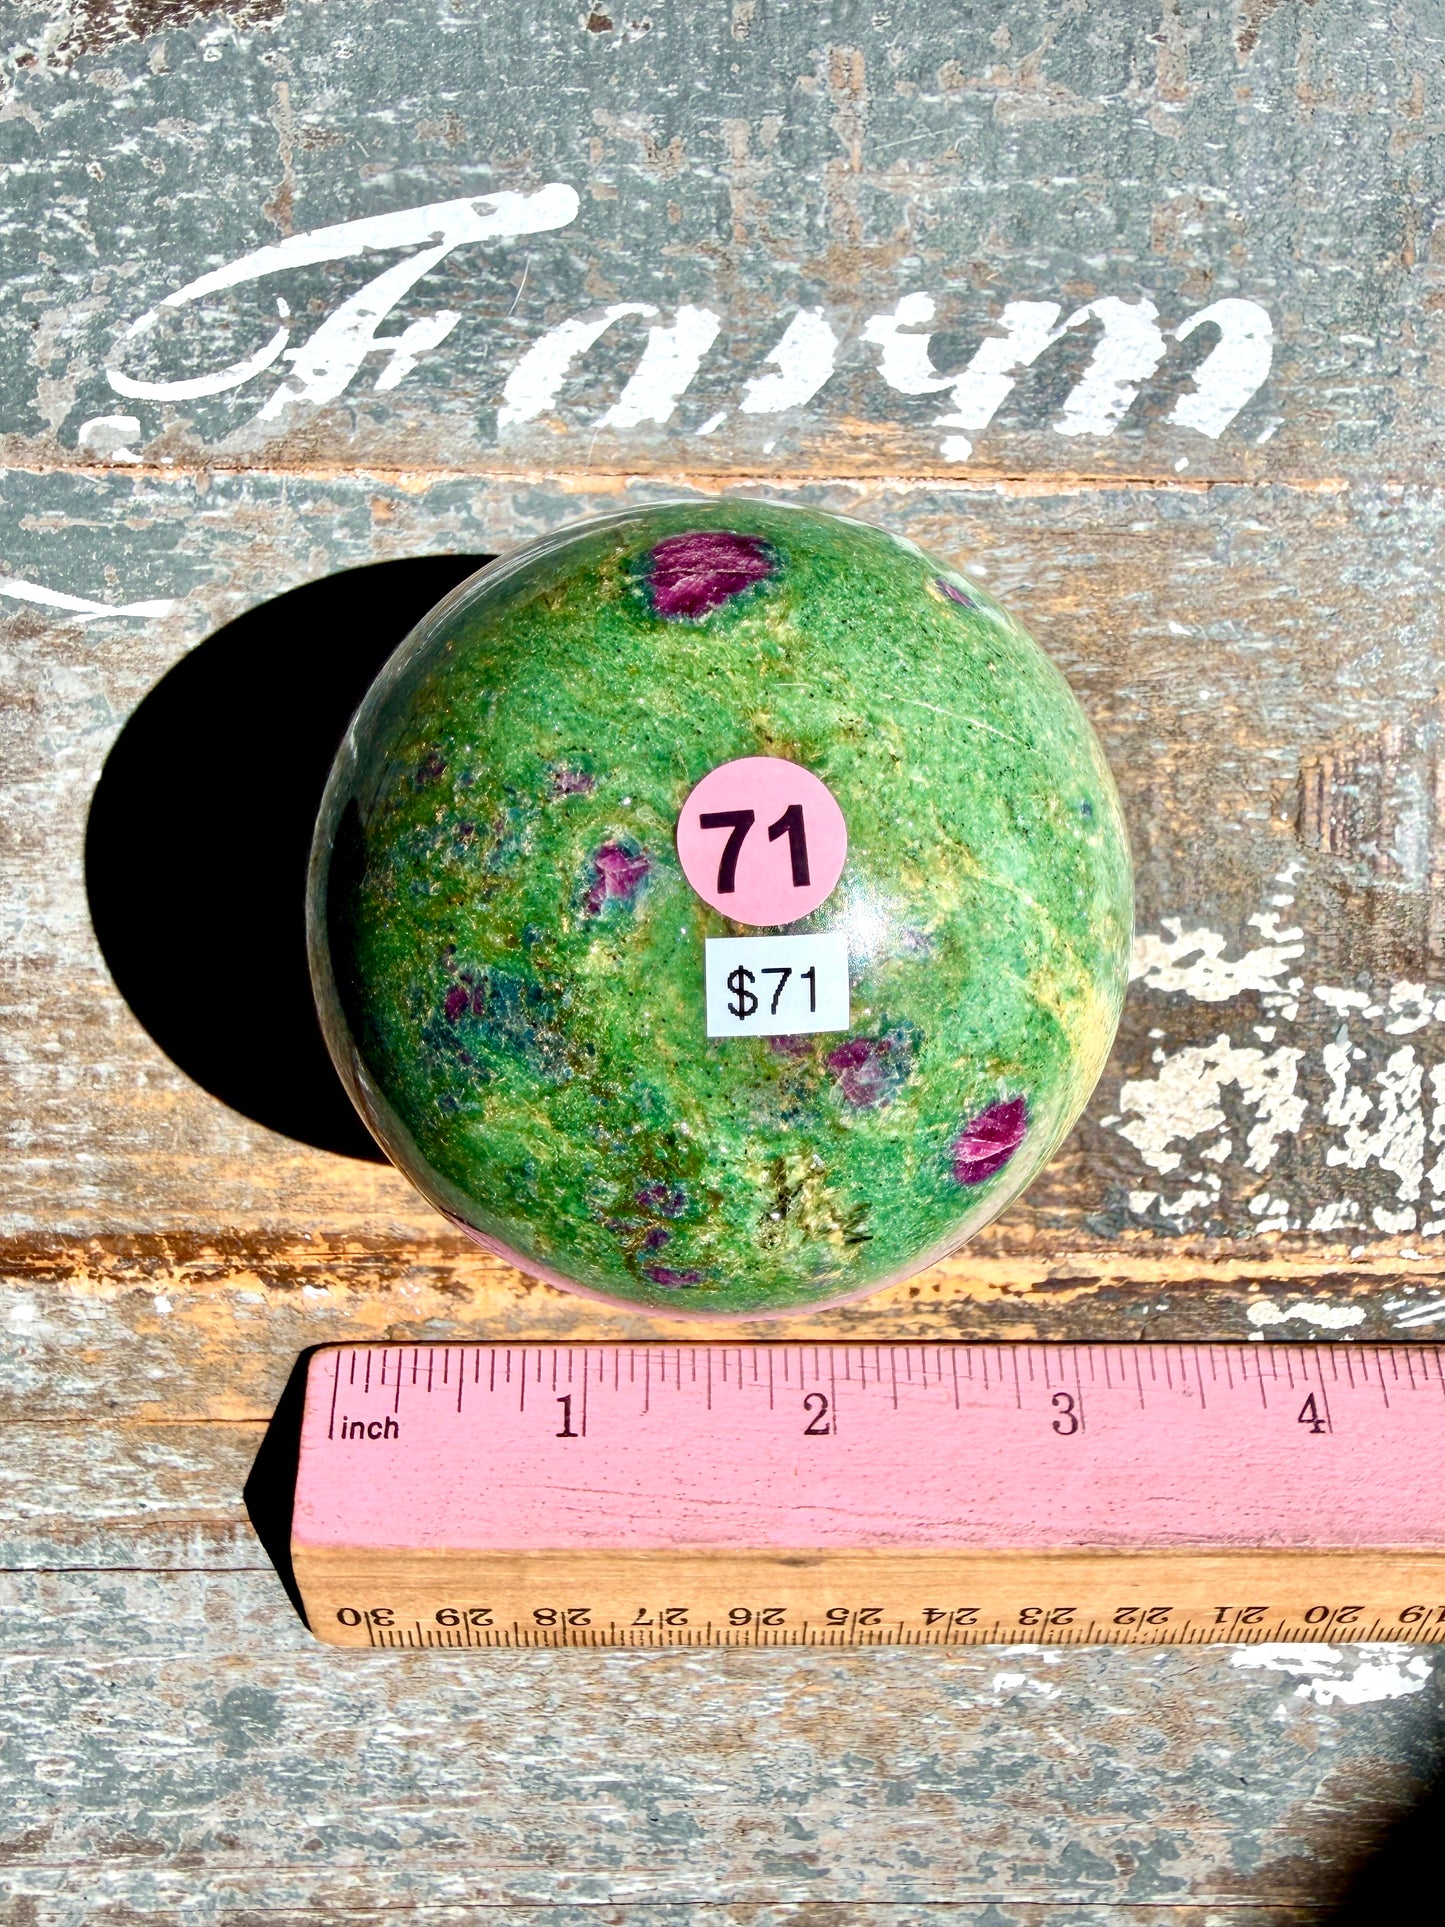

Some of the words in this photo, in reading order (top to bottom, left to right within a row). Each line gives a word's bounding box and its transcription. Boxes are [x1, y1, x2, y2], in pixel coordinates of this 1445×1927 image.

[699, 804, 811, 894] 71
[726, 964, 817, 1021] $71
[340, 1415, 400, 1440] inch
[554, 1393, 579, 1438] 1
[802, 1392, 831, 1436] 2
[1051, 1392, 1079, 1436] 3
[1297, 1392, 1326, 1435] 4
[335, 1607, 396, 1627] 30
[434, 1607, 494, 1627] 29
[532, 1607, 592, 1627] 28
[630, 1607, 690, 1627] 27
[727, 1607, 788, 1627] 26
[825, 1607, 885, 1627] 25
[921, 1607, 982, 1626] 24
[1018, 1607, 1078, 1626] 23
[1112, 1606, 1174, 1625] 22
[1213, 1606, 1271, 1625] 21
[1303, 1605, 1366, 1624] 20
